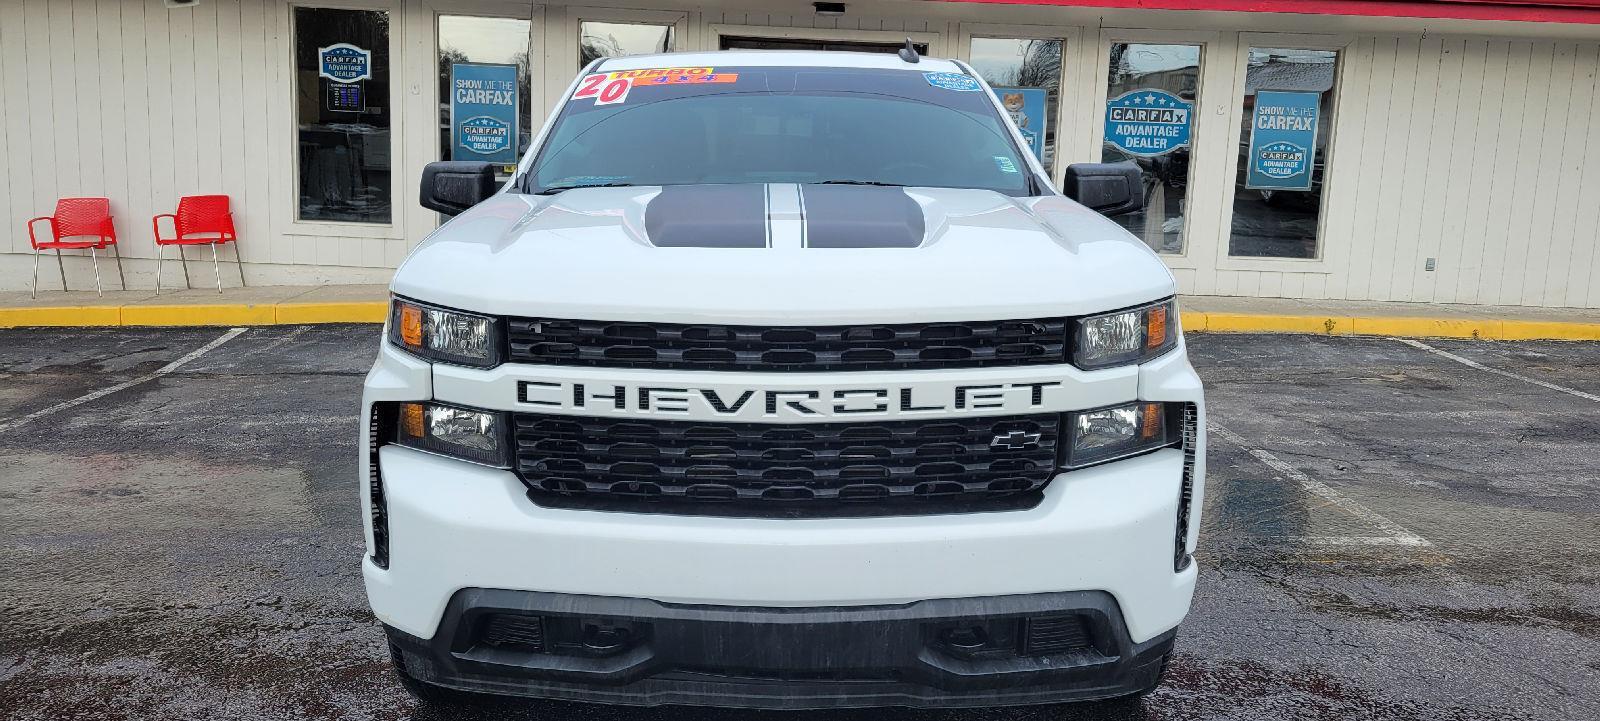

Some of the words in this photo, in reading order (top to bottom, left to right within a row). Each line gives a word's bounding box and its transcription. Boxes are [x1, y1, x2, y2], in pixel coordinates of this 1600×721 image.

[325, 56, 365, 65] CARFAX
[328, 64, 363, 72] ADVANTAGE
[612, 68, 708, 79] TURBO
[456, 79, 482, 89] SHOW
[484, 80, 496, 89] ME
[498, 80, 513, 90] THE
[574, 74, 628, 103] 20
[456, 89, 513, 106] CARFAX
[1113, 109, 1185, 123] CARFAX
[1258, 106, 1284, 115] SHOW
[1286, 107, 1298, 116] ME
[1300, 107, 1315, 117] THE
[1257, 115, 1313, 131] CARFAX
[464, 127, 505, 135] CARFAX
[1115, 124, 1181, 137] ADVANTAGE
[466, 135, 503, 144] ADVANTAGE
[1125, 137, 1168, 149] DEALER
[473, 142, 497, 150] DEALER
[1261, 152, 1302, 160] CARFAX
[1263, 160, 1299, 168] ADVANTAGE
[1268, 167, 1292, 175] DEALER
[517, 379, 1062, 417] CHEVROLET
